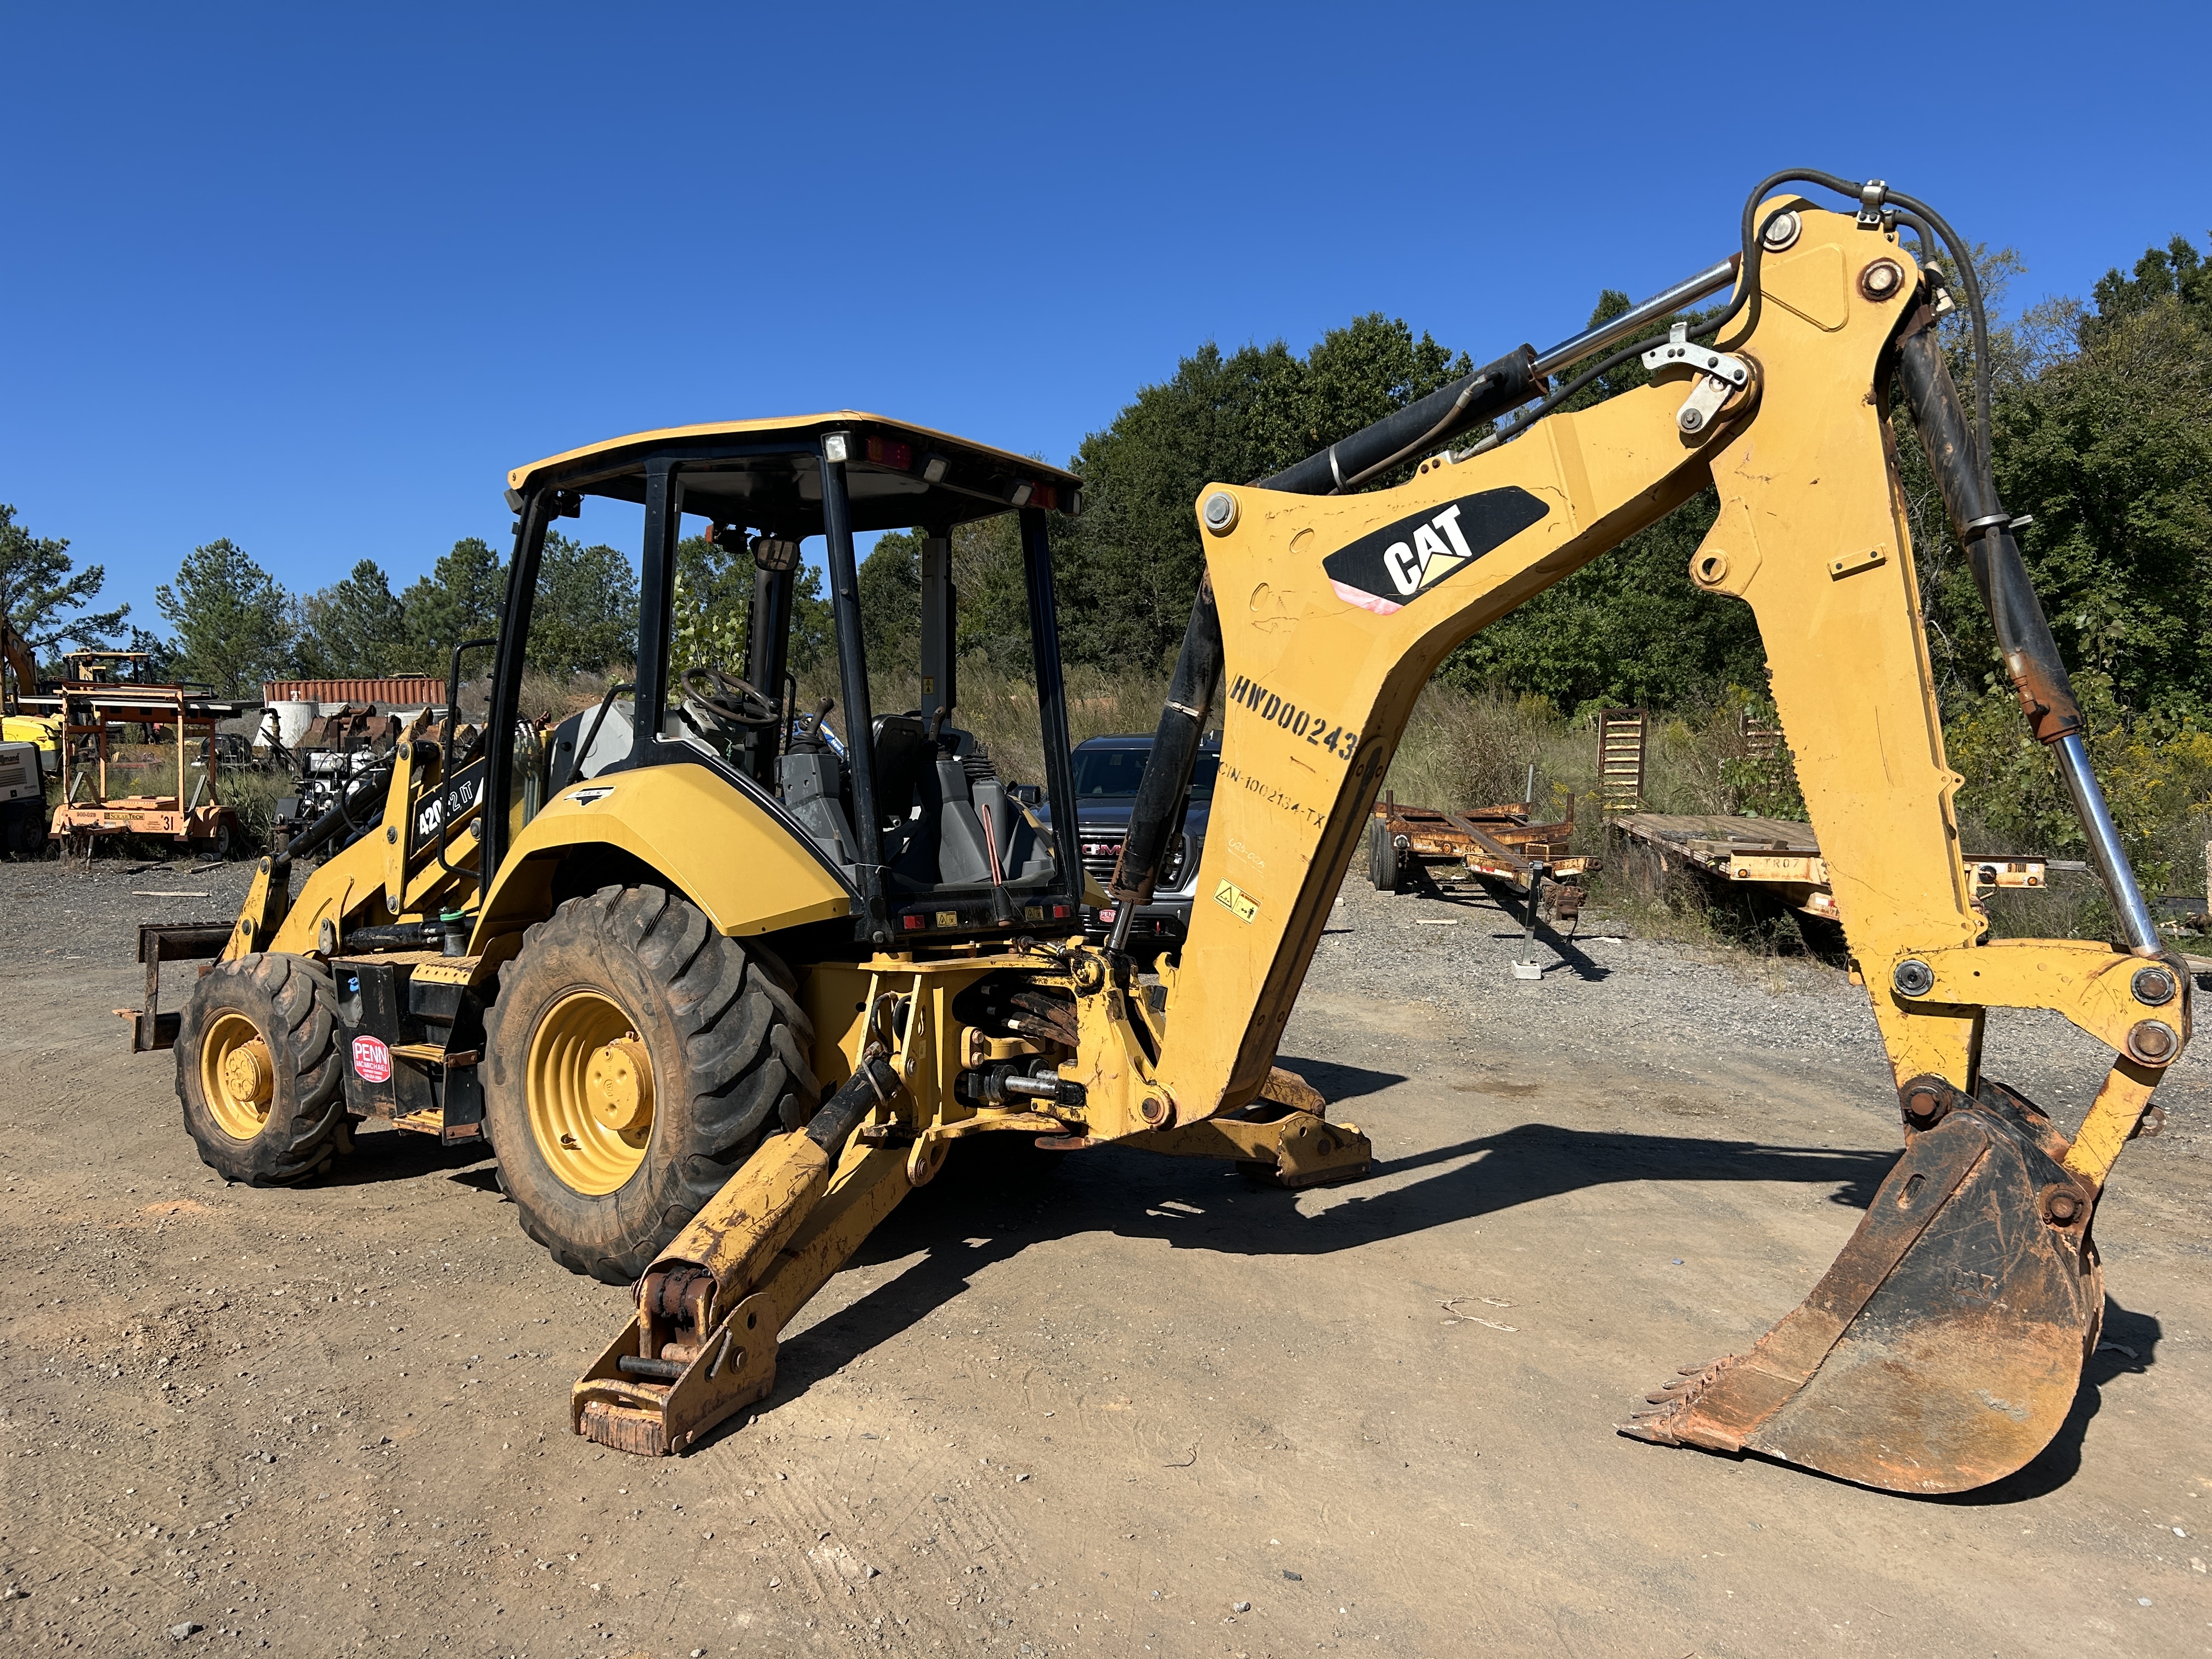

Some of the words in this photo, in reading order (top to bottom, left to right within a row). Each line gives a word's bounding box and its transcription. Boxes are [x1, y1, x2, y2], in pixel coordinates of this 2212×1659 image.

[1383, 504, 1472, 596] CAT
[1230, 675, 1358, 760] HWD00243
[1082, 844, 1120, 855] GM
[2015, 864, 2026, 873] TON
[354, 1042, 387, 1064] PENN
[356, 1060, 388, 1072] MCMICHAEL
[1946, 1265, 1996, 1301] CAT
